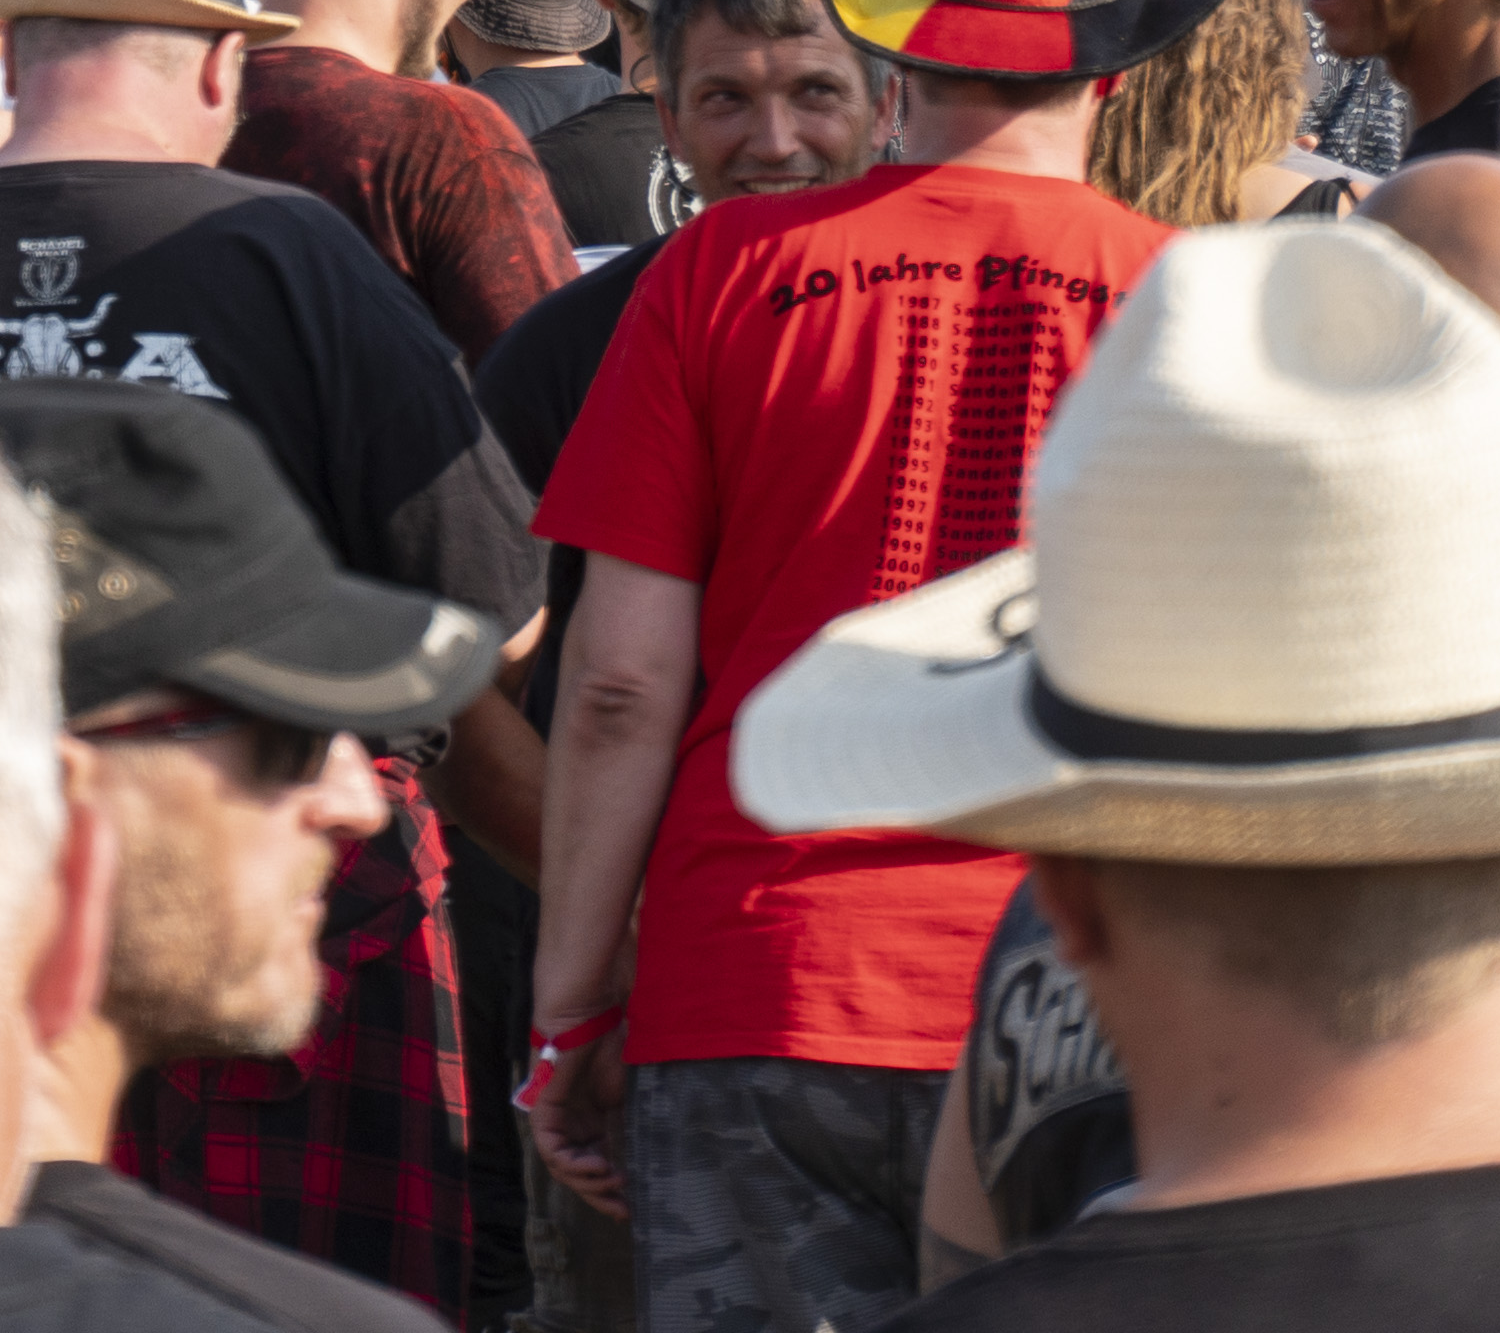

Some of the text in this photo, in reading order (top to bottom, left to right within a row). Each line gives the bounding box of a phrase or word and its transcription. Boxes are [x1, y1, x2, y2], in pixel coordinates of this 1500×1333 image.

[769, 268, 838, 318] 20
[898, 295, 941, 311] 1987
[897, 315, 940, 331] 1988
[897, 335, 940, 351] 1989
[892, 415, 933, 433] 1993
[890, 435, 931, 453] 1994
[888, 456, 930, 474] 1995
[887, 475, 929, 494] 1996
[885, 495, 927, 514] 1997
[882, 516, 924, 534] 1998
[879, 535, 923, 555] 1999
[875, 556, 920, 575] 2000
